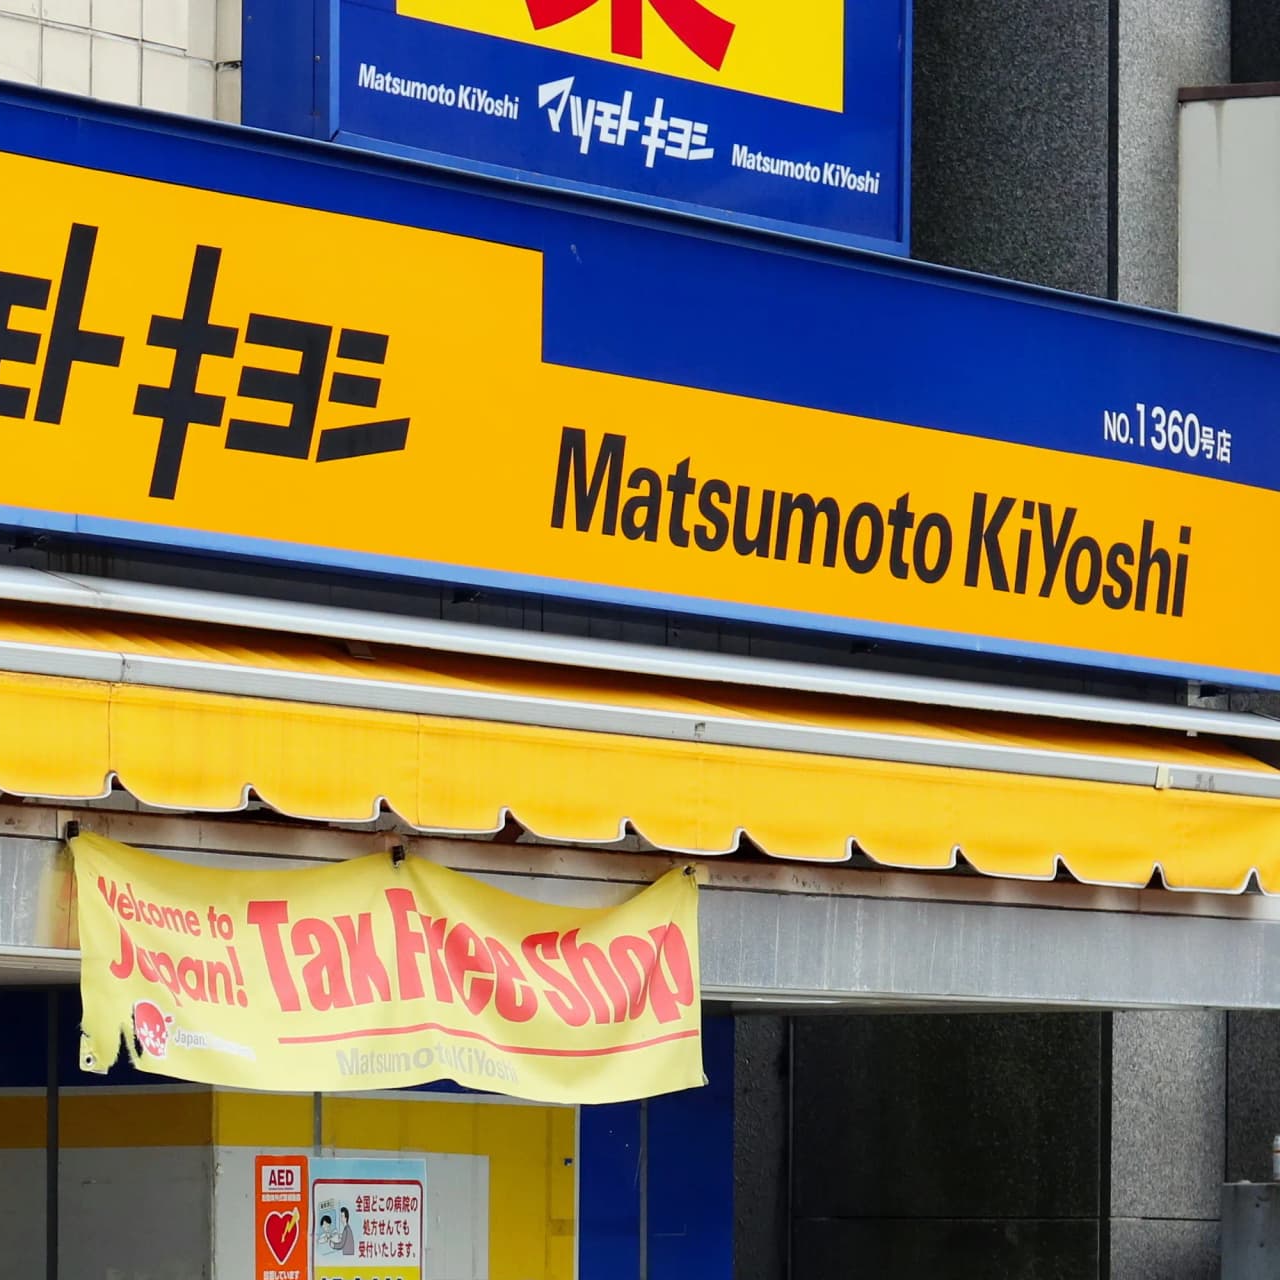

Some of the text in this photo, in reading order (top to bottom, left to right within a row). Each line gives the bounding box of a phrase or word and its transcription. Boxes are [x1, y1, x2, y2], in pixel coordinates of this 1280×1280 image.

[358, 63, 520, 120] Matsumoto KiYoshi
[538, 76, 714, 168] マツモトキヨシ
[731, 142, 880, 195] Matsumoto KiYoshi
[550, 426, 1193, 618] Matsumoto KiYoshi
[206, 905, 234, 941] to
[109, 921, 249, 1009] Japan!
[247, 887, 695, 1027] Tax Free Shop
[268, 1169, 294, 1187] AED
[355, 1196, 418, 1213] 全国どこの病院の
[362, 1220, 410, 1236] 処方せんでも
